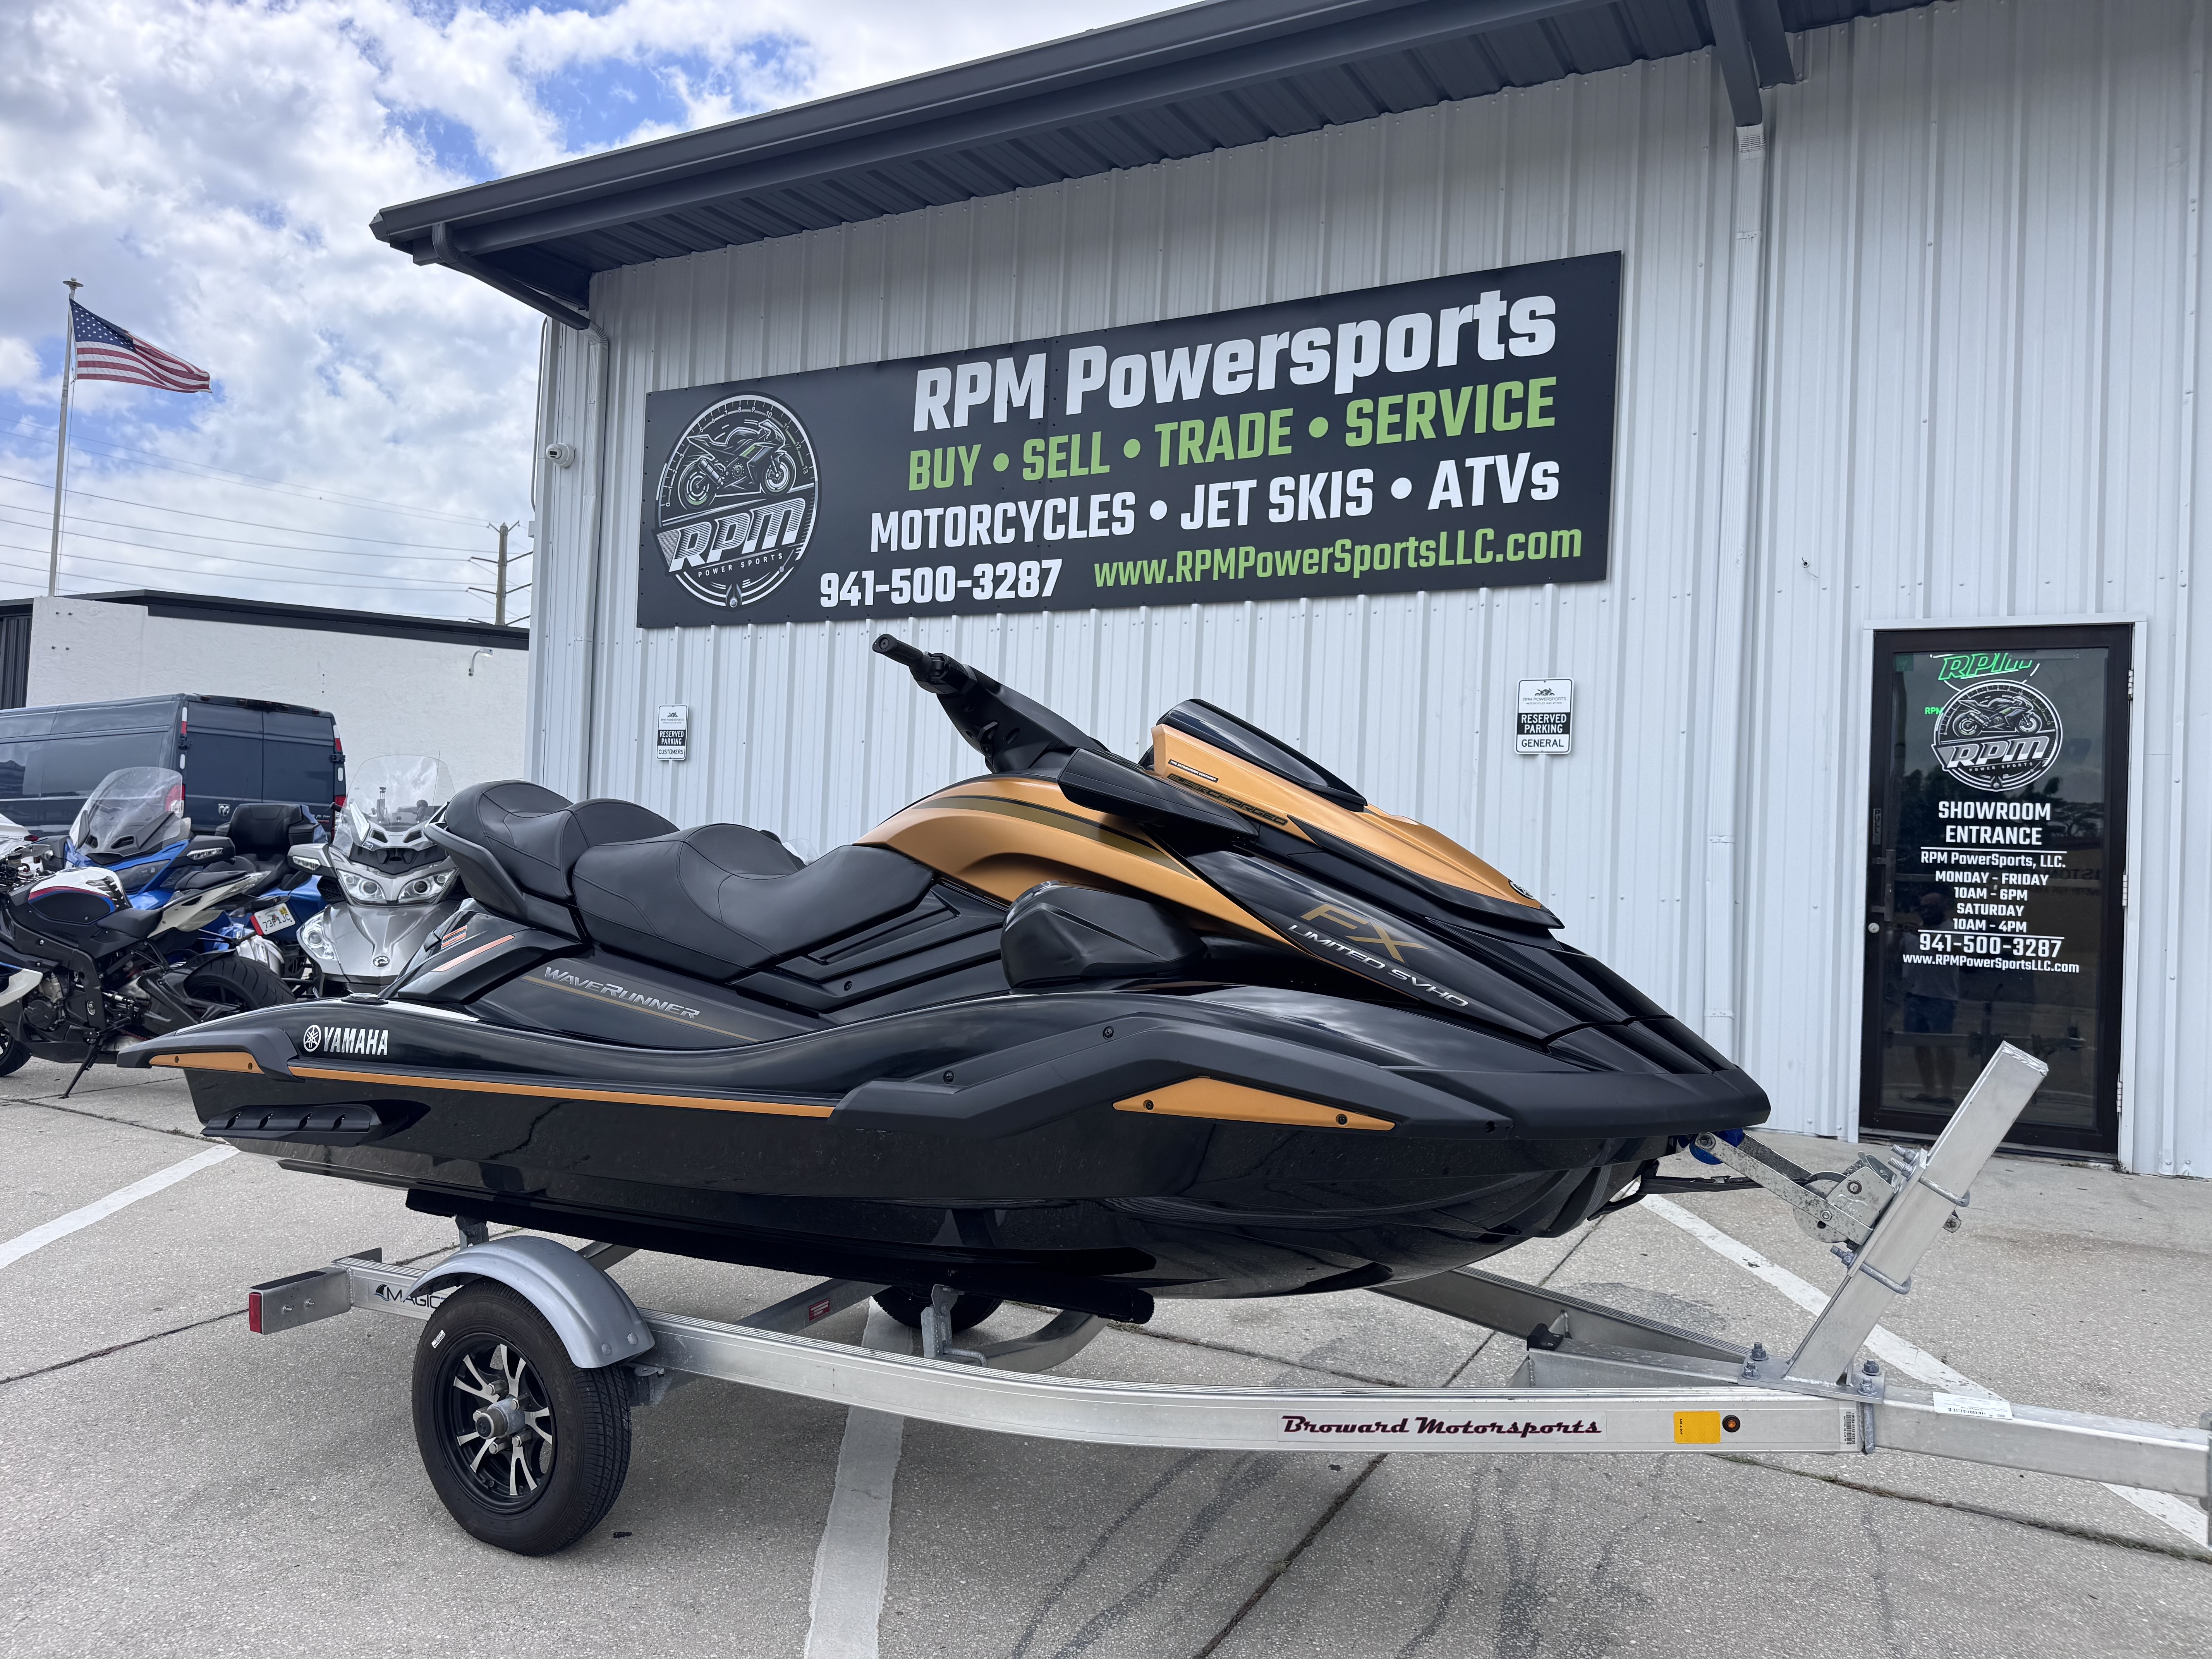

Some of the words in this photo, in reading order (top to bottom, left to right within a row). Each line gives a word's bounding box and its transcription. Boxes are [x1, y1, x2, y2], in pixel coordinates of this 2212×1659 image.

[914, 353, 1046, 432] RPM
[1066, 290, 1556, 416] Powersports
[909, 444, 982, 491] BUY
[1022, 431, 1110, 481] SELL
[1155, 408, 1293, 467] TRADE
[1345, 376, 1557, 447] SERVICE
[871, 492, 1135, 553] MOTORCYCLES
[1180, 479, 1257, 530] JET
[1269, 468, 1374, 523] SKIS
[1427, 452, 1559, 510] ATVs
[670, 498, 806, 573] RPM
[698, 563, 733, 577] POWER
[740, 553, 784, 568] SPORTS
[1094, 528, 1582, 587] www.RPMPowerSportsLLC.com
[820, 559, 1062, 608] 941-500-3287
[1521, 714, 1567, 723] RESERVED
[1524, 724, 1563, 733] PARKING
[1522, 739, 1564, 747] GENERAL
[1947, 735, 2049, 768] RPM
[1168, 774, 1288, 826] SUPERCHARGED
[1938, 801, 2051, 821] SHOWROOM
[1946, 825, 2042, 845] ENTRANCE
[1921, 852, 1948, 864] RPM
[1951, 853, 2036, 869] PowerSports,
[2040, 855, 2066, 868] LLC.
[1935, 871, 1989, 883] MONDAY
[2001, 873, 2049, 886] FRIDAY
[1954, 887, 1987, 899] 10AM
[1999, 889, 2028, 901] 6PM
[1956, 903, 2025, 917] SATURDAY
[1300, 903, 1430, 963] FX
[1953, 918, 1986, 931] 10AM
[1998, 921, 2027, 933] 4PM
[1920, 933, 2062, 958] 941-500-3287
[1287, 924, 1386, 969] LIMITED
[1388, 969, 1469, 1007] SVHO
[1903, 954, 2080, 973] www.RPMPowerSportsLLC.com
[323, 1027, 388, 1056] YAMAHA
[1281, 1415, 1409, 1434] Broward
[1414, 1416, 1602, 1438] Motorsports
